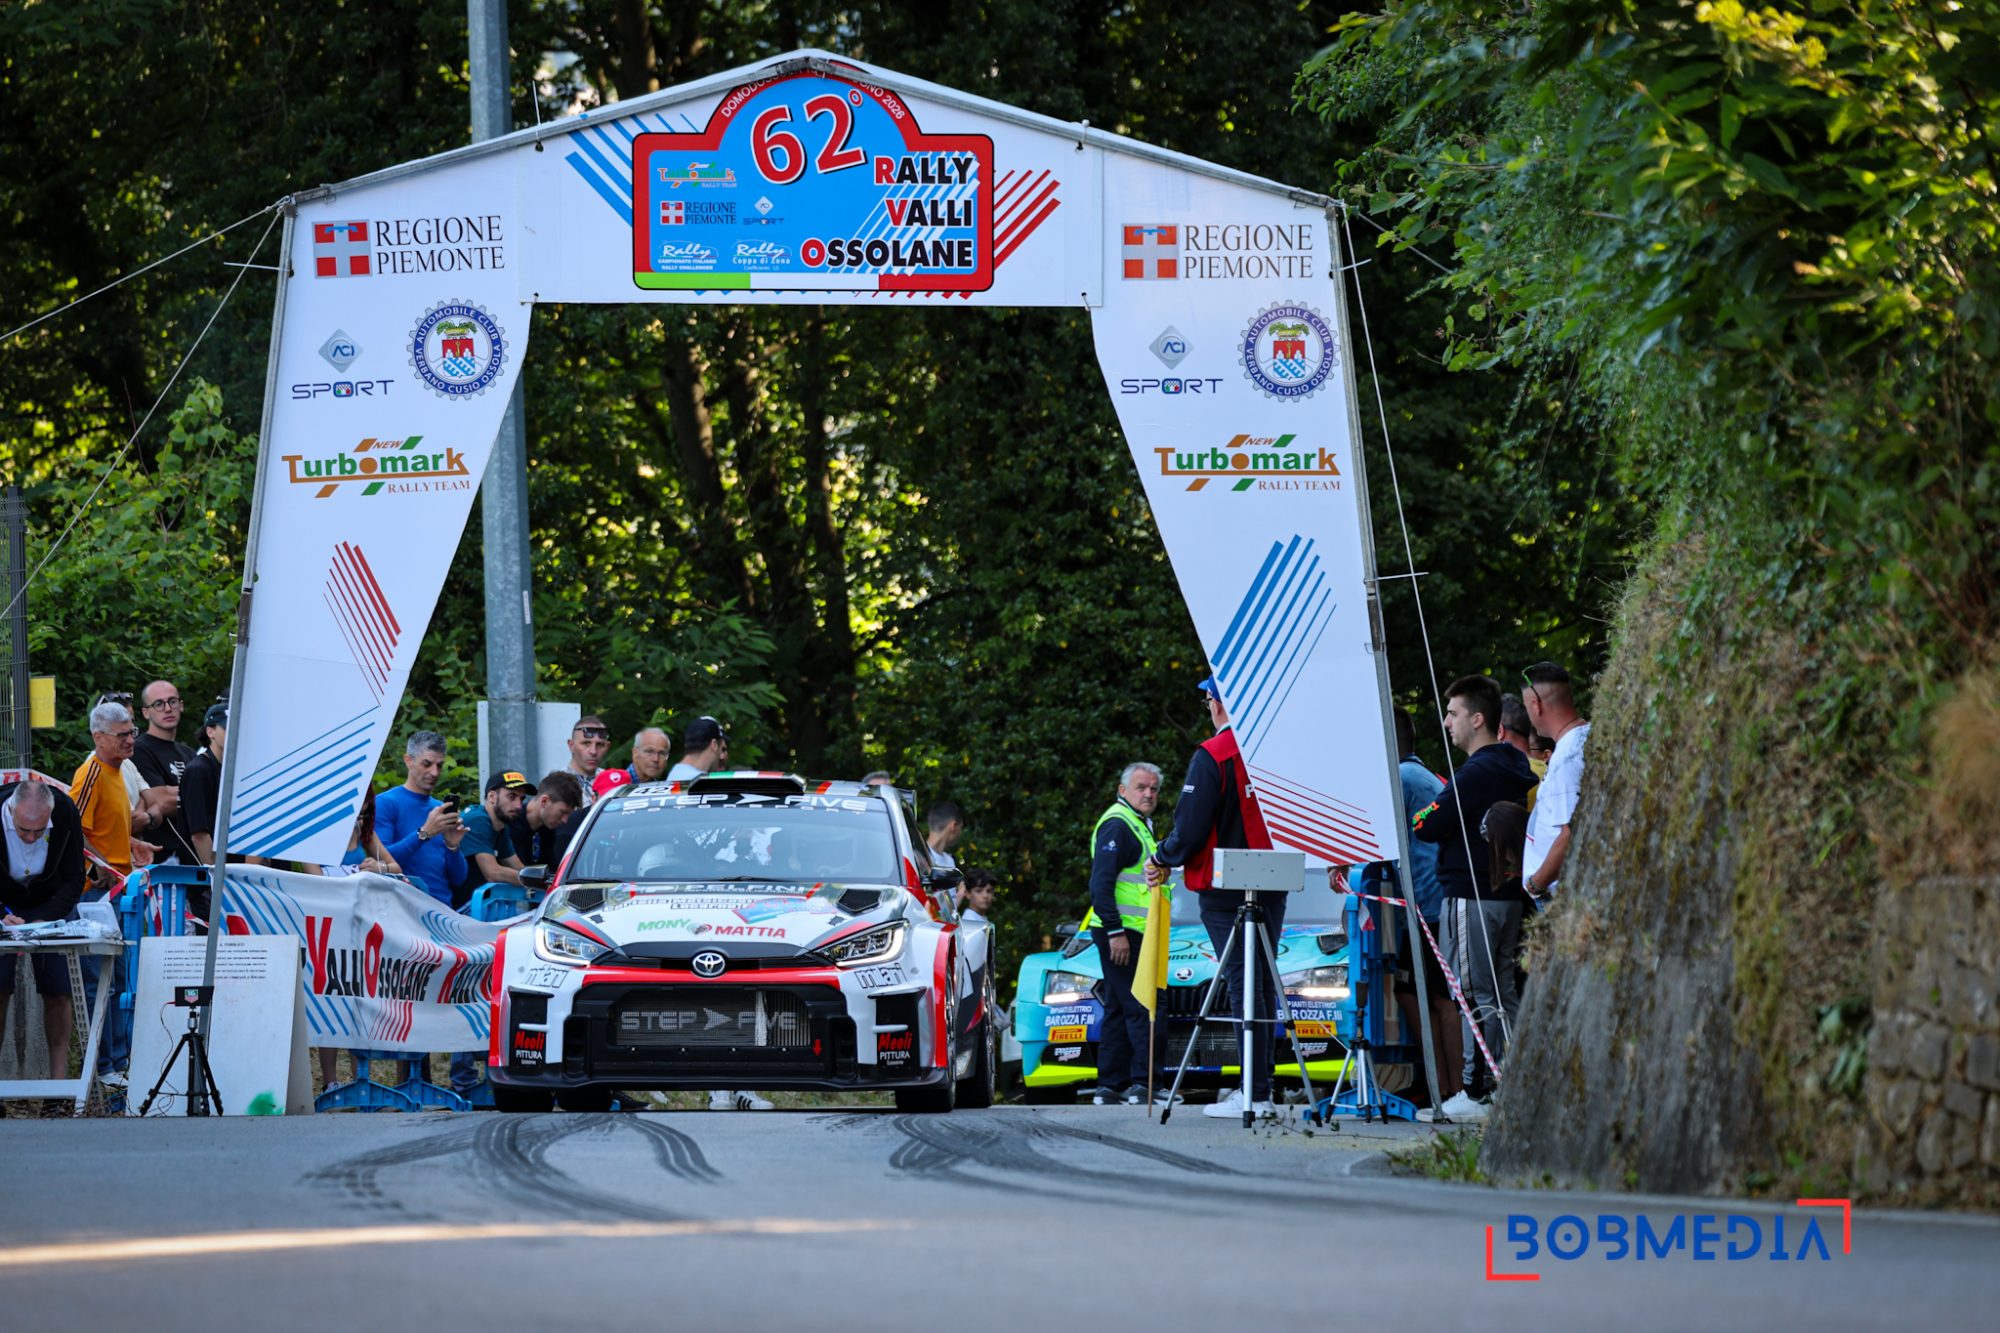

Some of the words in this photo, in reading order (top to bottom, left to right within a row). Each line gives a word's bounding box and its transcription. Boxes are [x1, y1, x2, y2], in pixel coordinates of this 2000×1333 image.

[882, 94, 905, 119] 2026
[874, 156, 974, 185] RALLY
[685, 202, 736, 213] REGIONE
[886, 199, 973, 227] VALLI
[685, 215, 737, 225] PIEMONTE
[375, 215, 504, 246] REGIONE
[1184, 224, 1313, 251] REGIONE
[376, 246, 505, 274] PIEMONTE
[663, 243, 711, 259] Rally
[736, 242, 785, 259] Rally
[800, 238, 974, 268] OSSOLANE
[1184, 255, 1313, 279] PIEMONTE
[416, 307, 477, 344] AUTOMOBILE
[478, 315, 499, 341] CLUB
[1248, 308, 1310, 344] AUTOMOBILE
[1310, 317, 1331, 343] CLUB
[332, 345, 355, 358] ACI
[1163, 341, 1186, 354] ACI
[415, 347, 445, 390] VERBANO
[447, 381, 480, 394] CUSIO
[481, 344, 501, 383] OSSOLA
[1246, 348, 1274, 390] VERBANO
[1276, 384, 1309, 396] CUSIO
[1310, 347, 1333, 385] OSSOLA
[292, 380, 395, 400] SPORT
[1120, 378, 1224, 395] SPORT
[374, 440, 404, 449] NEW
[1245, 437, 1276, 446] NEW
[282, 448, 470, 484] Turbomark
[1154, 447, 1341, 476] Turbomark
[388, 482, 431, 494] RALLY
[433, 480, 470, 492] TEAM
[1258, 480, 1301, 491] RALLY
[1303, 480, 1341, 491] TEAM
[635, 785, 672, 796] 42
[623, 793, 730, 811] STEP
[784, 795, 867, 812] FIVE
[637, 918, 691, 932] MONY
[715, 925, 786, 938] MATTIA
[621, 1011, 697, 1031] STEP
[514, 1030, 544, 1051] Meoli
[878, 1031, 912, 1051] Meoli
[515, 1049, 543, 1061] PITTURA
[879, 1050, 911, 1061] PITTURA
